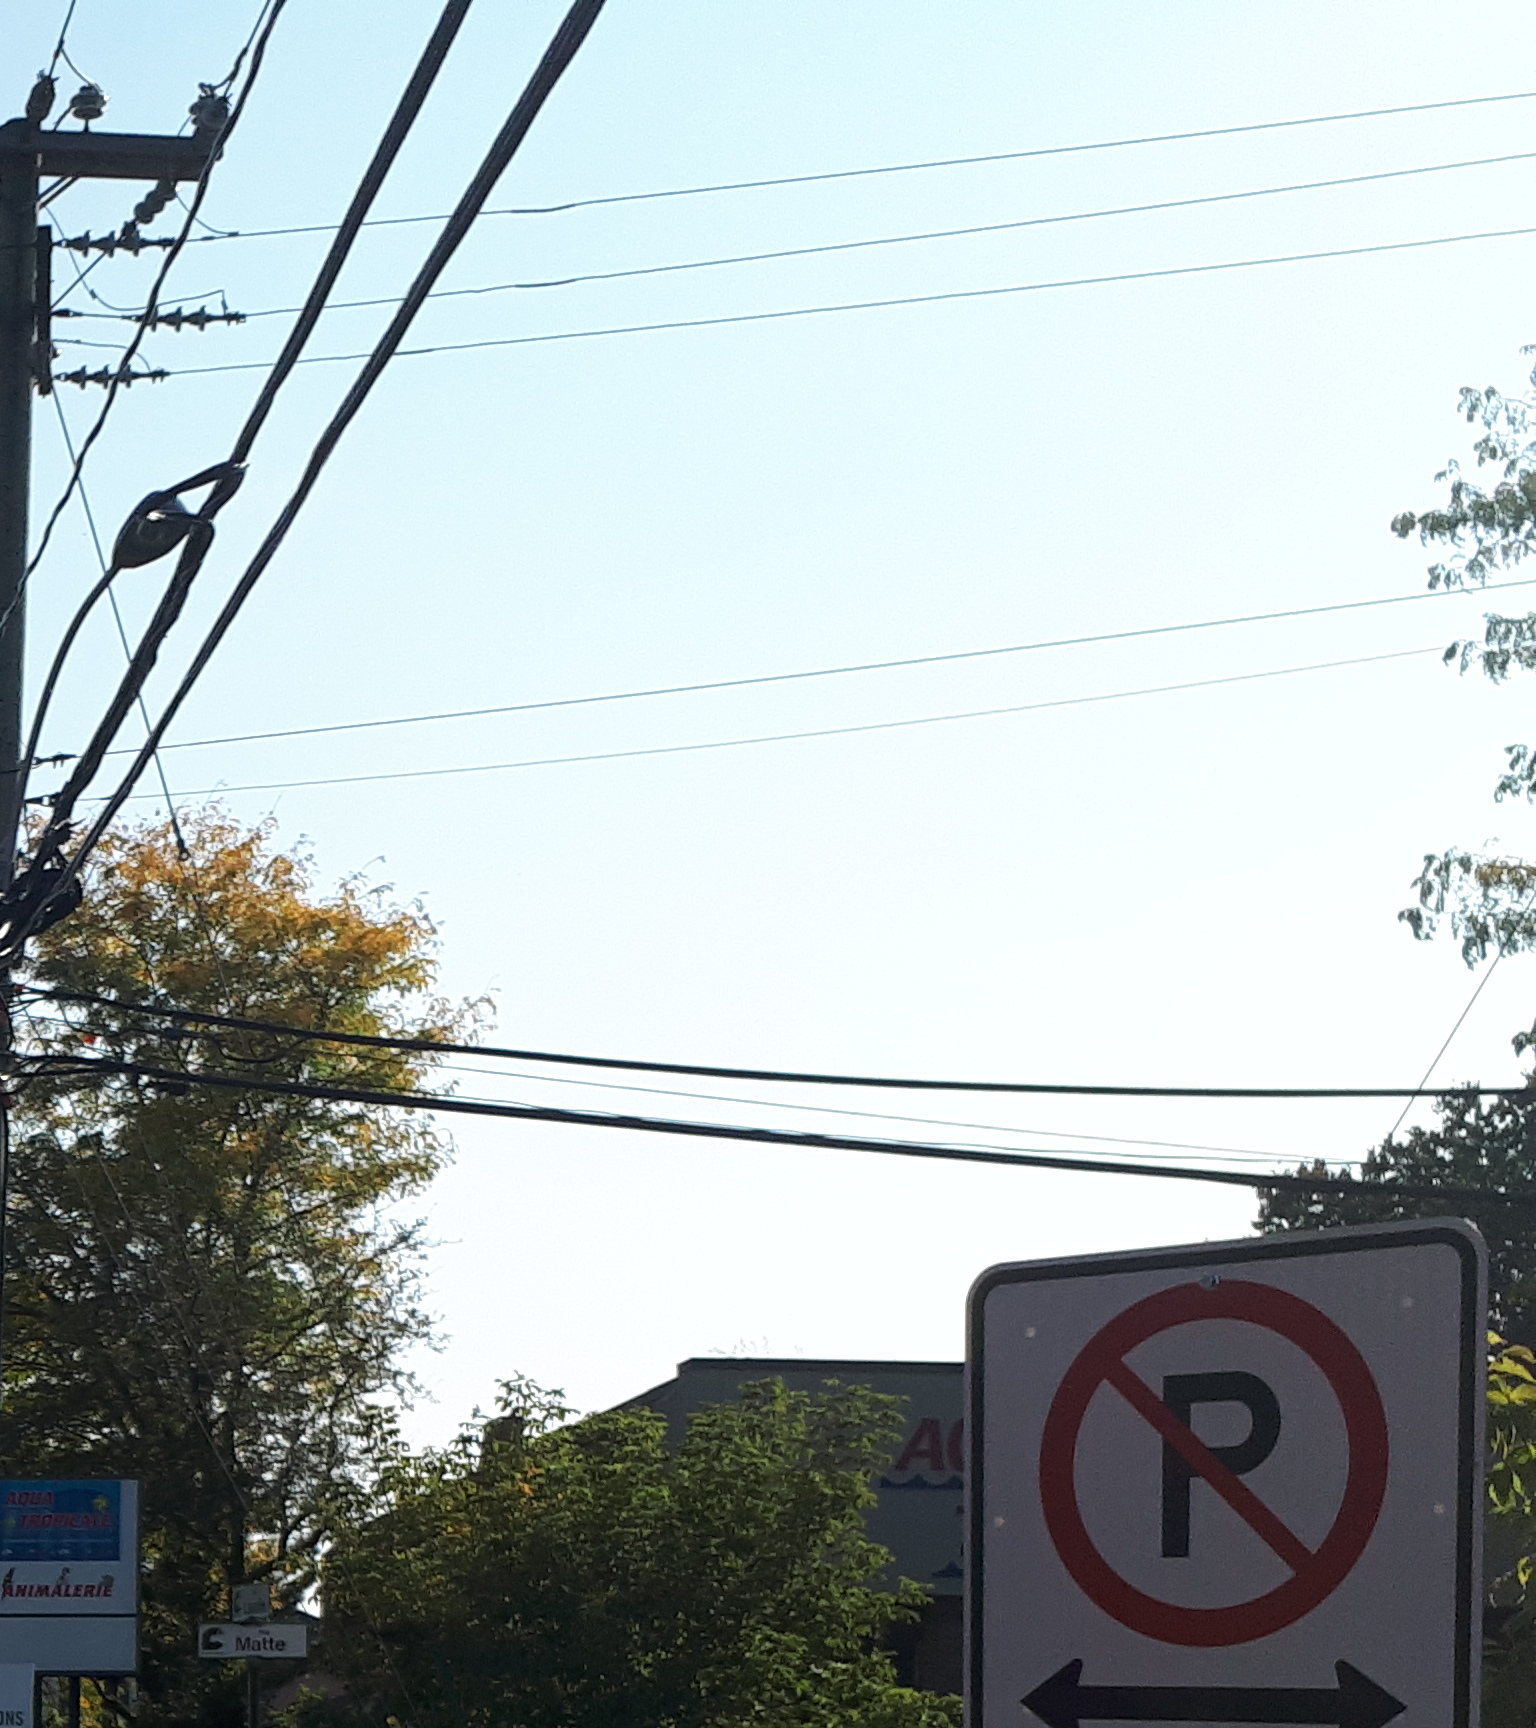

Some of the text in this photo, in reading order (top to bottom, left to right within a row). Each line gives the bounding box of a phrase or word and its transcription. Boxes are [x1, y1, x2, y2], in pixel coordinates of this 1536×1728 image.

[1161, 1370, 1281, 1558] P
[6, 1491, 55, 1505] AQUA
[3, 1584, 113, 1598] ANIMALERIE
[235, 1637, 287, 1652] Matte
